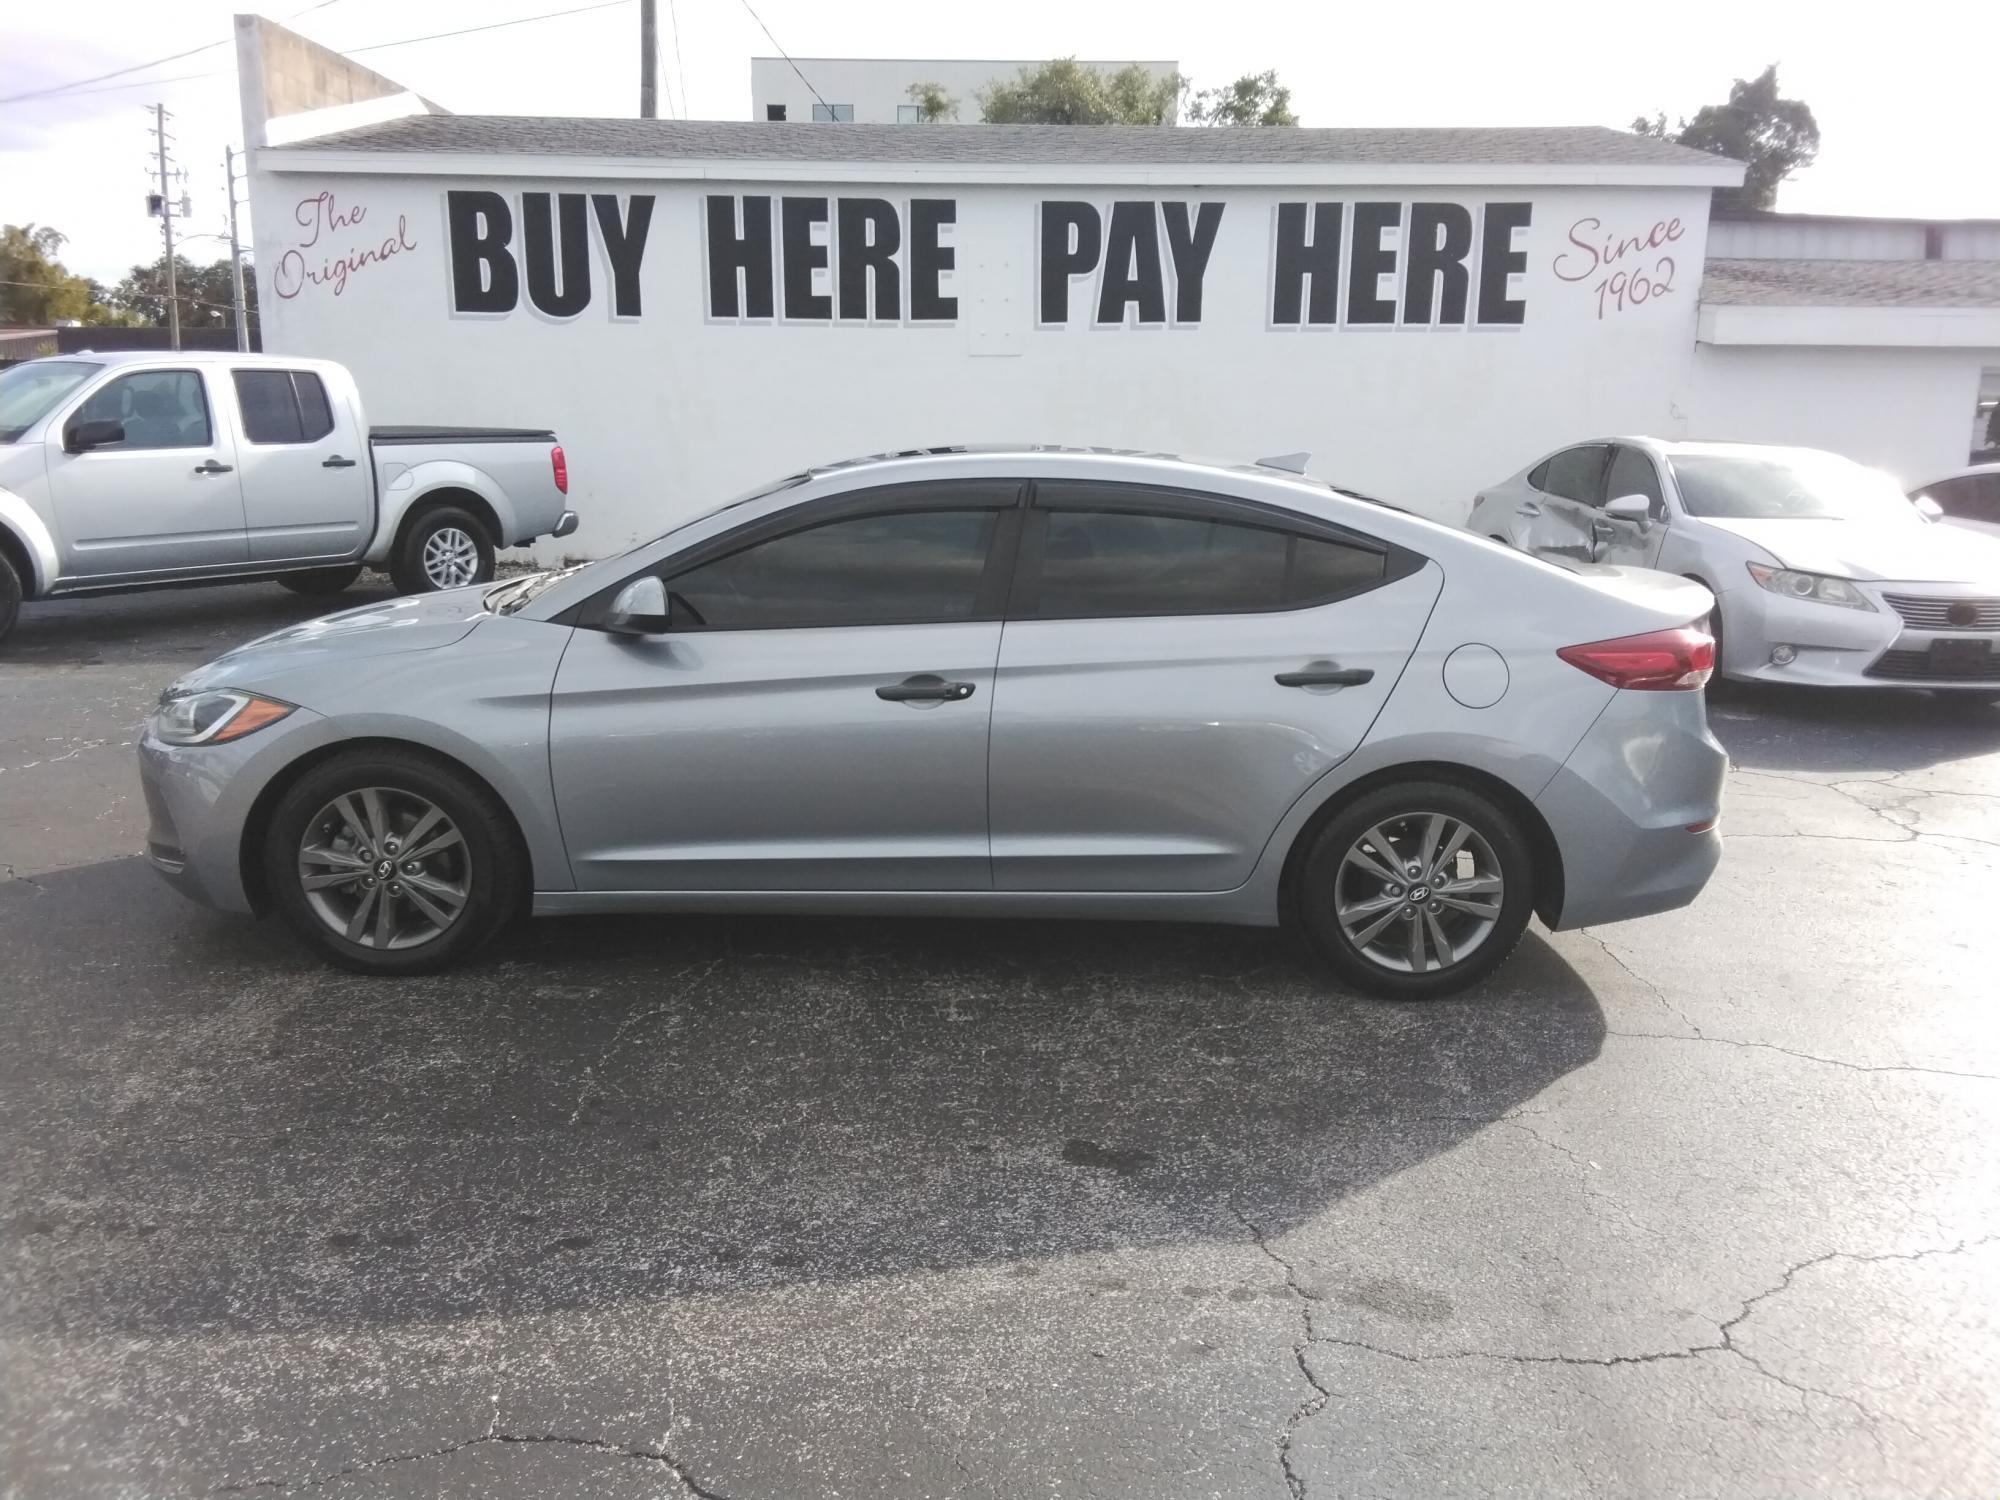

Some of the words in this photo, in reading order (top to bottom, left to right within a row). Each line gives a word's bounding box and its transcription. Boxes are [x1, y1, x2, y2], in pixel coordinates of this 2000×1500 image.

[295, 191, 367, 248] The
[1553, 217, 1686, 282] Since
[274, 215, 418, 299] Original
[445, 190, 656, 318] BUY
[704, 195, 958, 322] HERE
[1039, 200, 1227, 325] PAY
[1270, 202, 1532, 326] HERE
[1594, 256, 1676, 320] 1962
